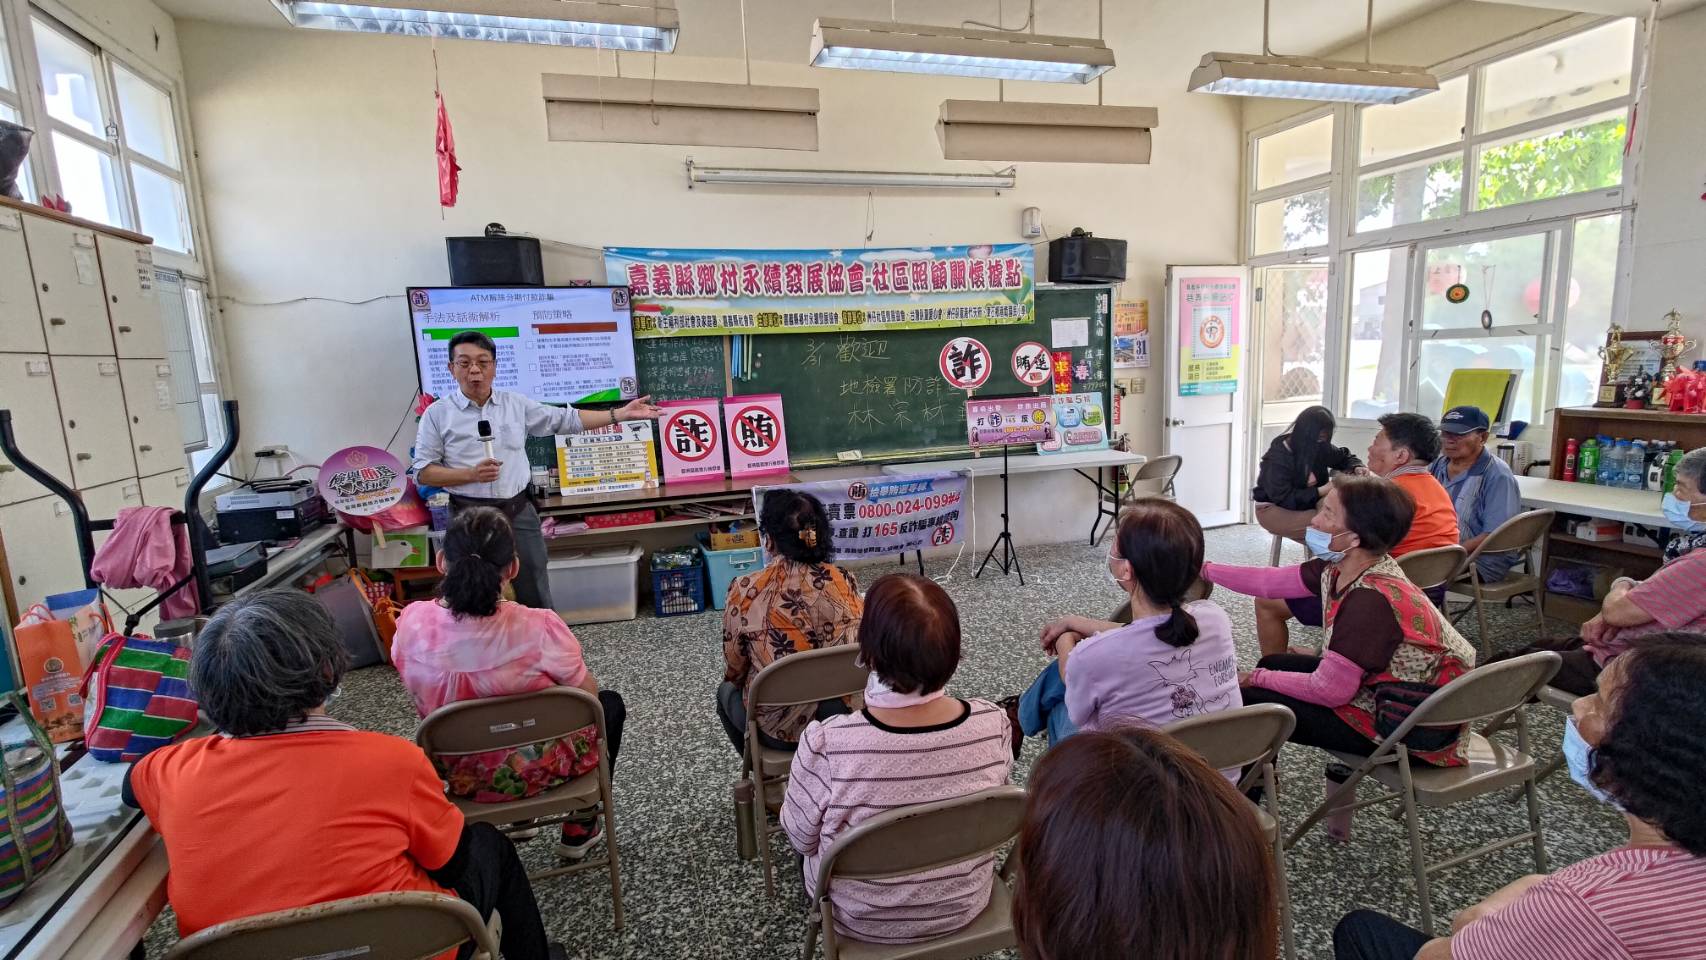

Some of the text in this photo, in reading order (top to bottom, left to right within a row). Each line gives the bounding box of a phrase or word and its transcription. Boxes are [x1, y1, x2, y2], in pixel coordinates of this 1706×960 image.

[423, 312, 501, 323] 手法及話術解析
[1136, 339, 1147, 355] 31
[948, 343, 983, 381] 詐
[675, 419, 709, 454] 詐
[741, 414, 774, 447] 賄
[873, 521, 898, 537] 165
